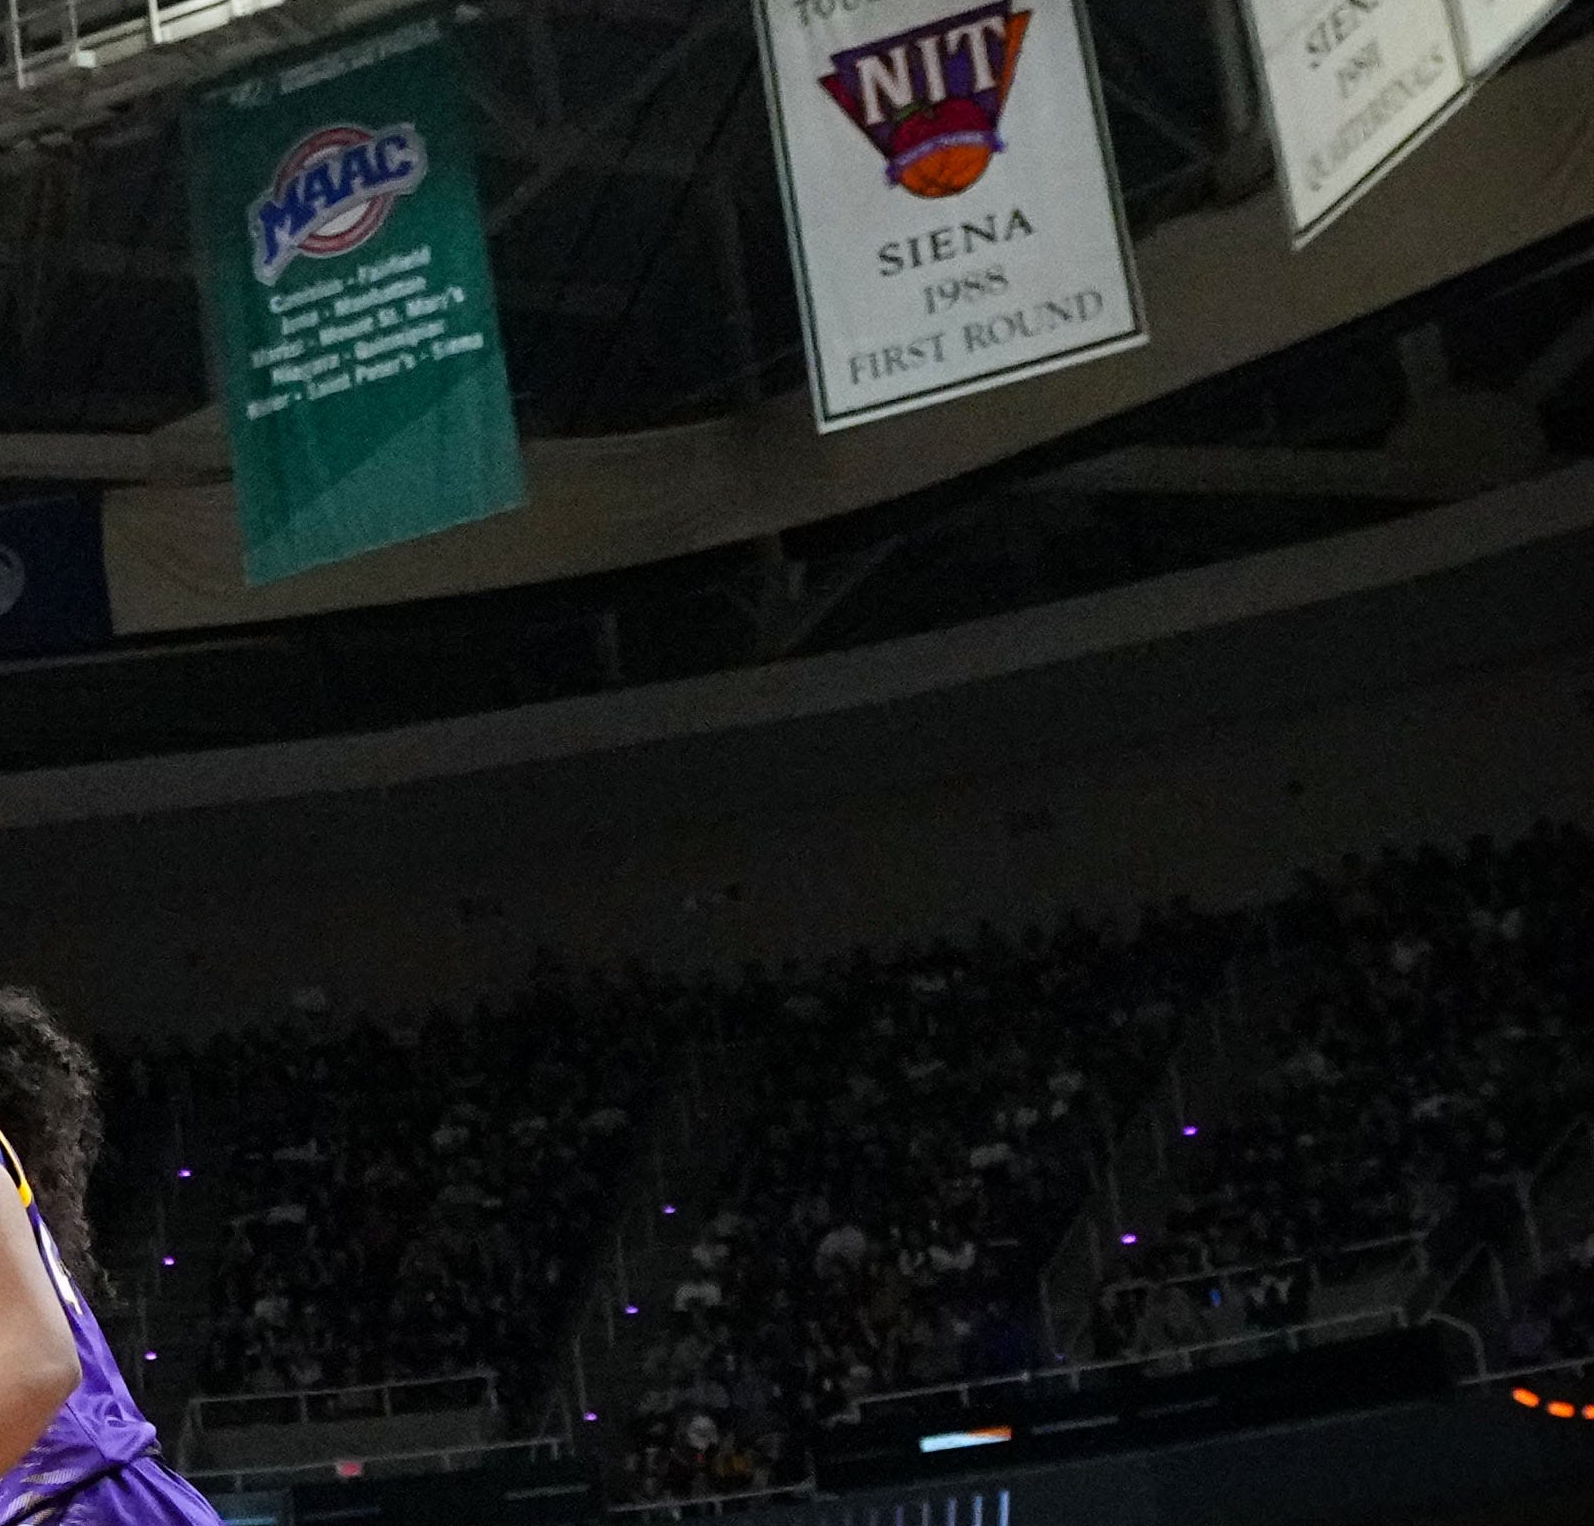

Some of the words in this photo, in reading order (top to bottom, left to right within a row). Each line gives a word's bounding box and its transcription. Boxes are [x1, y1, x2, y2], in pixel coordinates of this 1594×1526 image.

[853, 16, 1012, 127] NIT
[258, 134, 415, 266] MAAC
[878, 208, 1036, 277] SIENA
[846, 331, 950, 386] FIRST
[963, 289, 1105, 354] ROUND
[924, 270, 1010, 316] 1988
